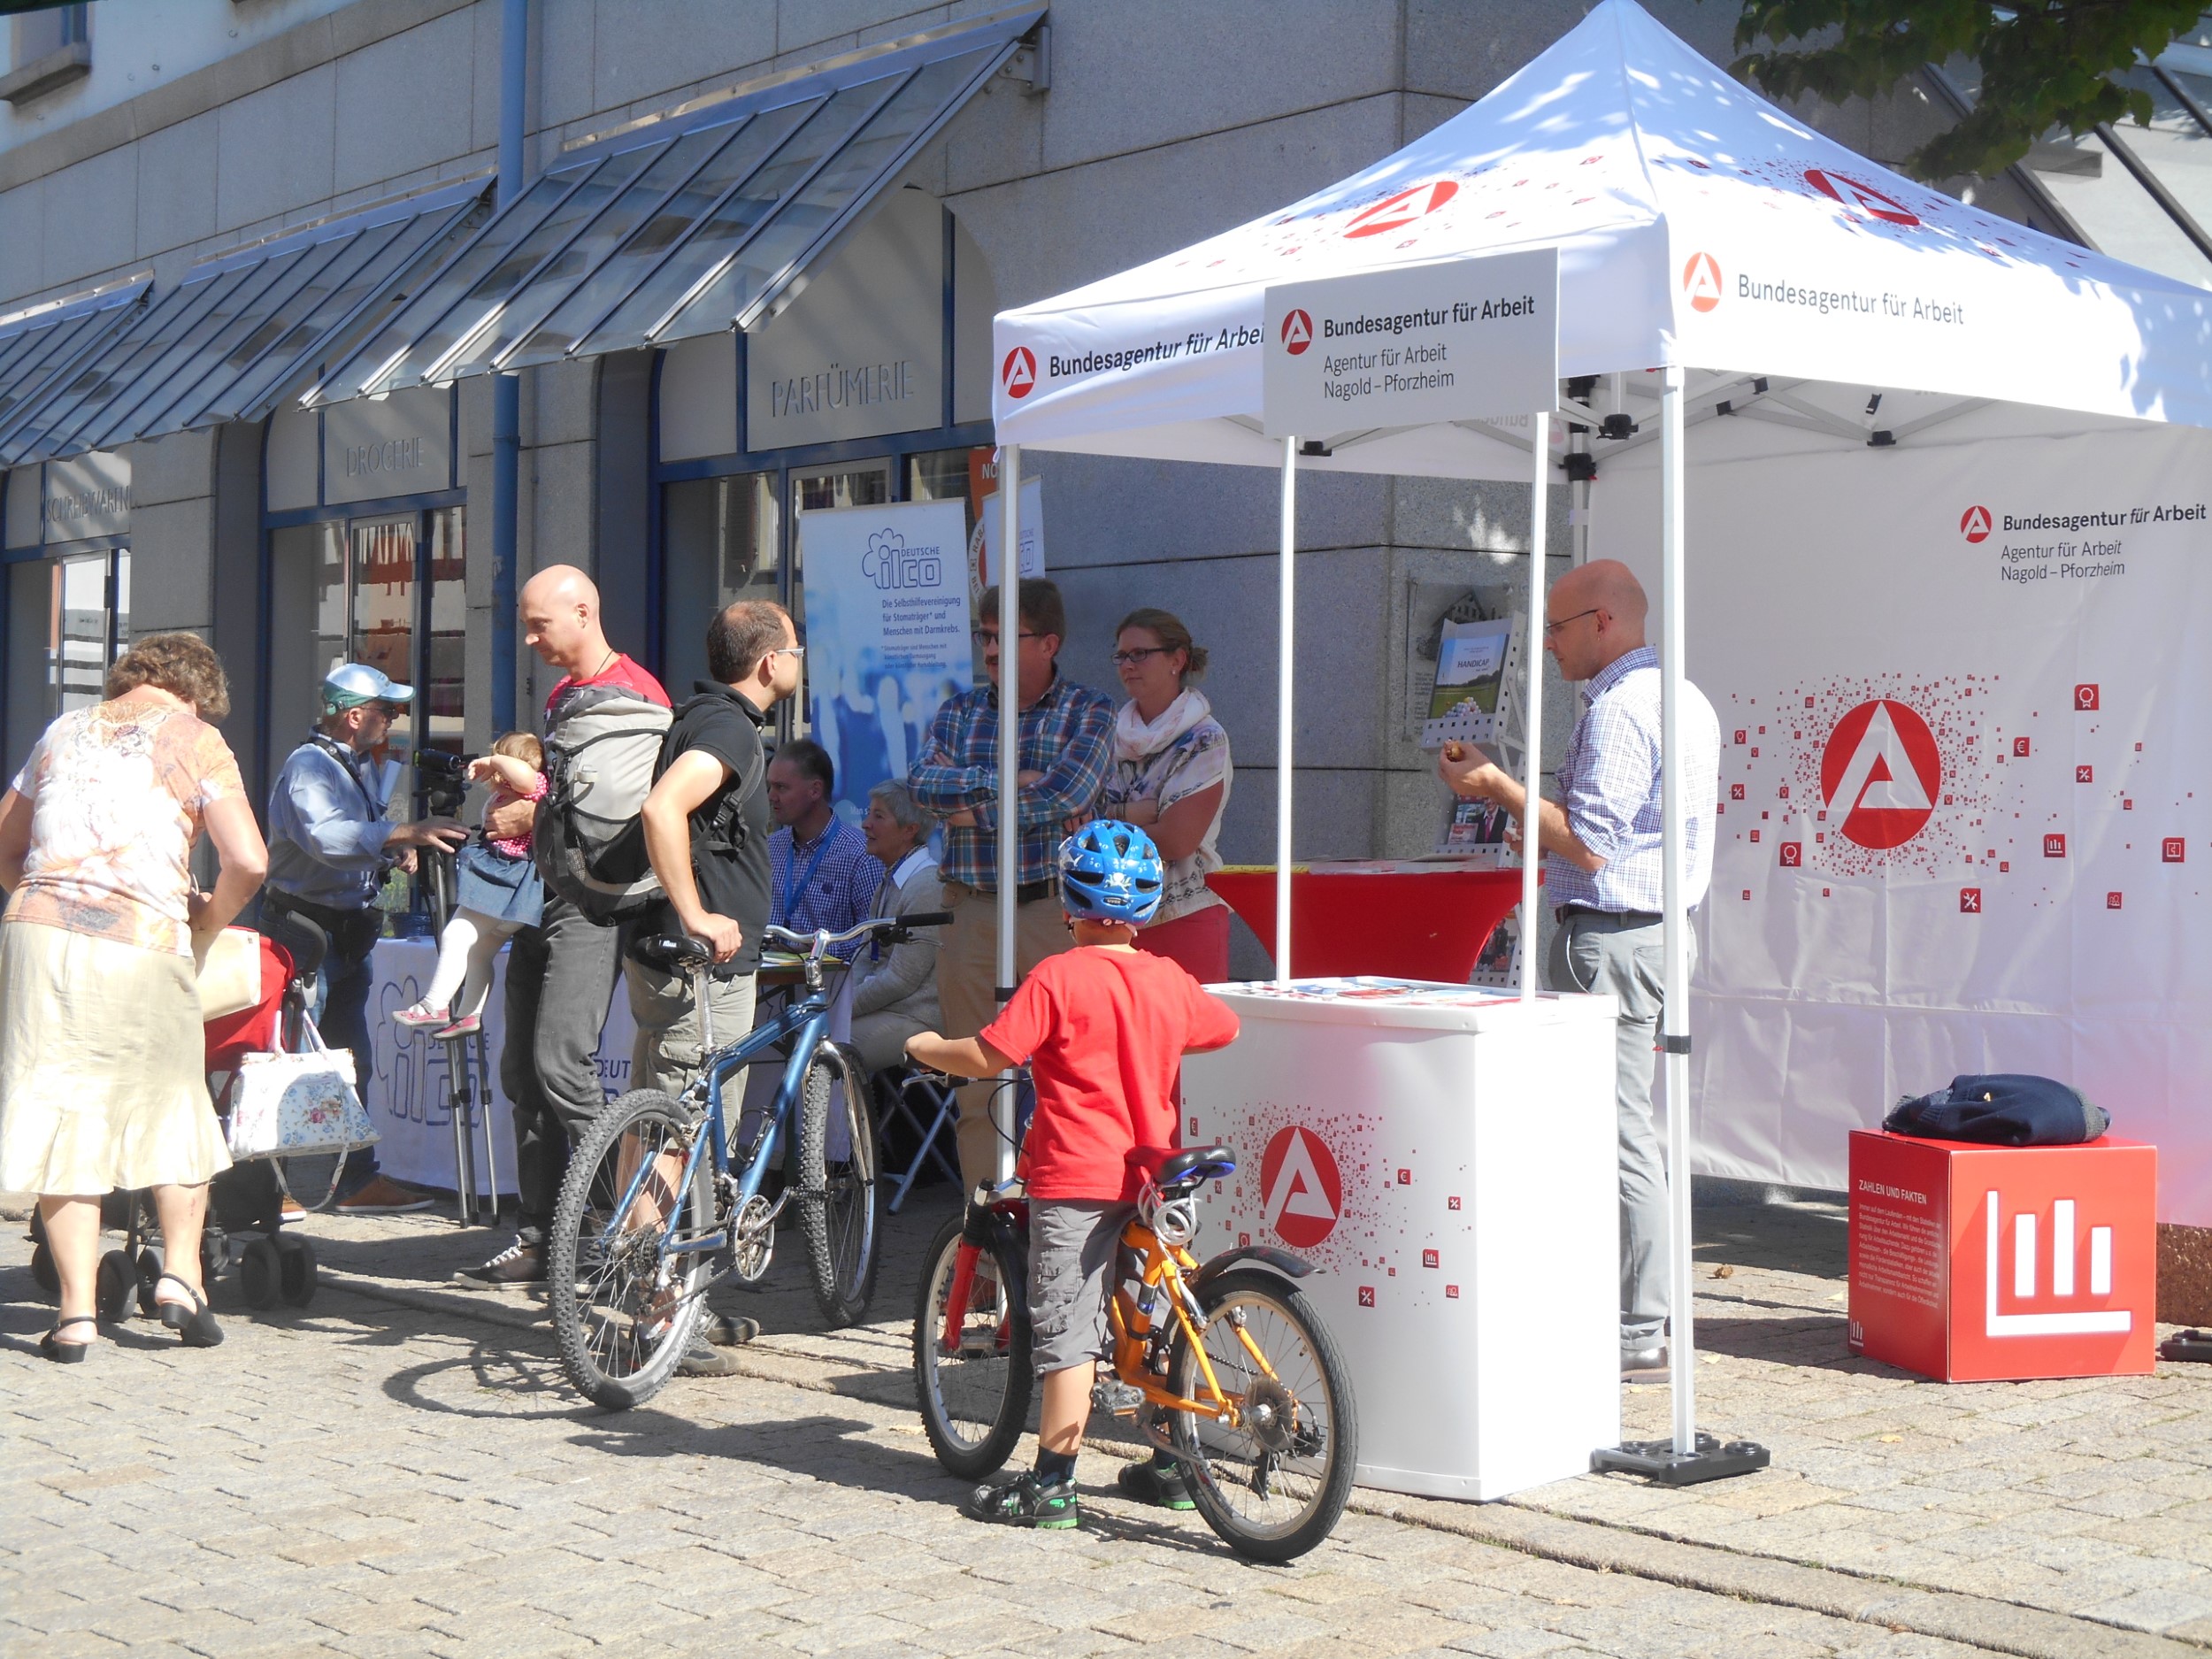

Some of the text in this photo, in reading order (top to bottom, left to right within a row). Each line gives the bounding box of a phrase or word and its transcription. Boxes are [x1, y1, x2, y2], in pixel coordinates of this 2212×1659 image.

[1739, 273, 1877, 314] Bundesagentur
[1882, 293, 1906, 317] für
[1913, 297, 1964, 325] Arbeit
[1324, 308, 1448, 338] Bundesagentur
[1452, 303, 1478, 323] für
[1480, 295, 1535, 319] Arbeit
[1050, 342, 1182, 377] Bundesagentur
[1186, 333, 1212, 355] für
[1216, 323, 1264, 351] Arbei
[1324, 343, 1447, 377] Agentur für Arbeit
[772, 360, 914, 418] PARFÜMERIE
[1324, 377, 1371, 402] Nagold
[1384, 369, 1454, 393] Pforzheim
[347, 437, 424, 477] DROGERIE
[2003, 511, 2127, 532] Bundesagentur
[2130, 508, 2150, 525] für
[2153, 504, 2207, 522] Arbeit
[901, 546, 941, 557] DEUTSCHE
[2001, 540, 2123, 563] Agentur für Arbeit
[2001, 564, 2047, 584] Nagold
[2061, 561, 2124, 579] Pforzheim
[882, 596, 961, 609] Die Selbsthilfevereinigung
[882, 612, 891, 622] für
[934, 610, 946, 619] und
[883, 624, 960, 635] Menschen mit Darmkrebs.
[1456, 658, 1490, 668] HANDICAP
[594, 1059, 631, 1079] DEUT
[1859, 1179, 1927, 1205] ZAHLEN UND FAKTEN
